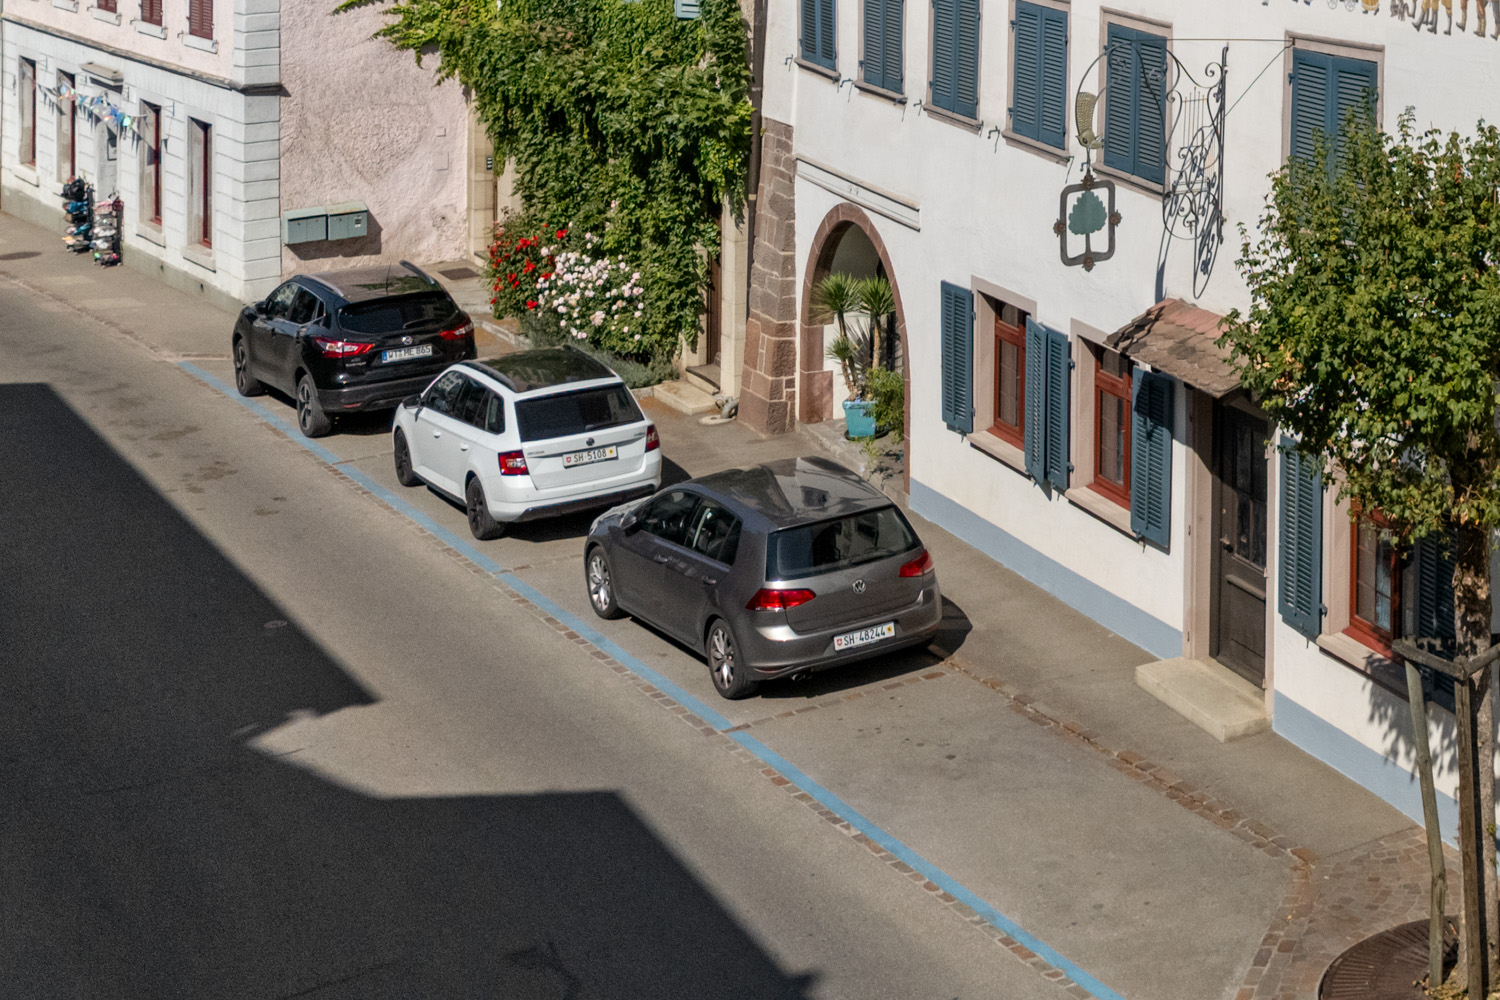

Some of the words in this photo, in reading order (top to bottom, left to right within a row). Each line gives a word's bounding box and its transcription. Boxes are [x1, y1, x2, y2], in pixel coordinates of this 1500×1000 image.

[574, 453, 584, 463] SH
[587, 449, 607, 460] 5108
[843, 633, 855, 646] SH
[859, 626, 886, 641] 48244
